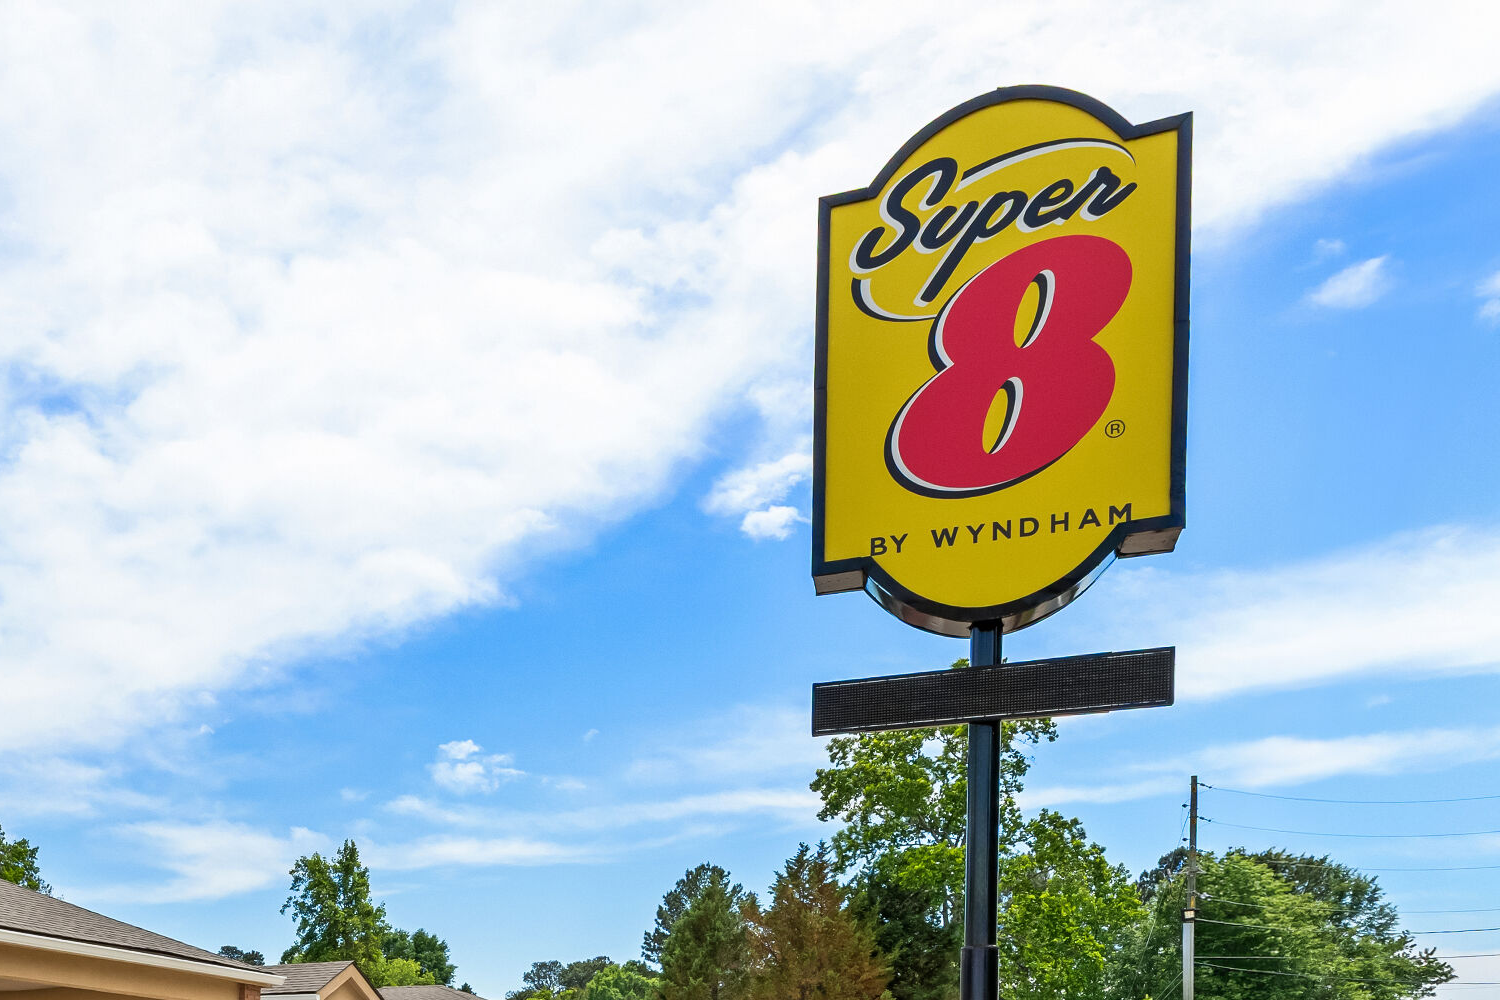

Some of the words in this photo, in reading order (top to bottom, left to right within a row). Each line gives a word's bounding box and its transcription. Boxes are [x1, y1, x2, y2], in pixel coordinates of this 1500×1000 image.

[849, 157, 1138, 307] Super
[884, 235, 1133, 499] 8
[870, 533, 909, 556] BY
[930, 503, 1132, 548] WYNDHAM
